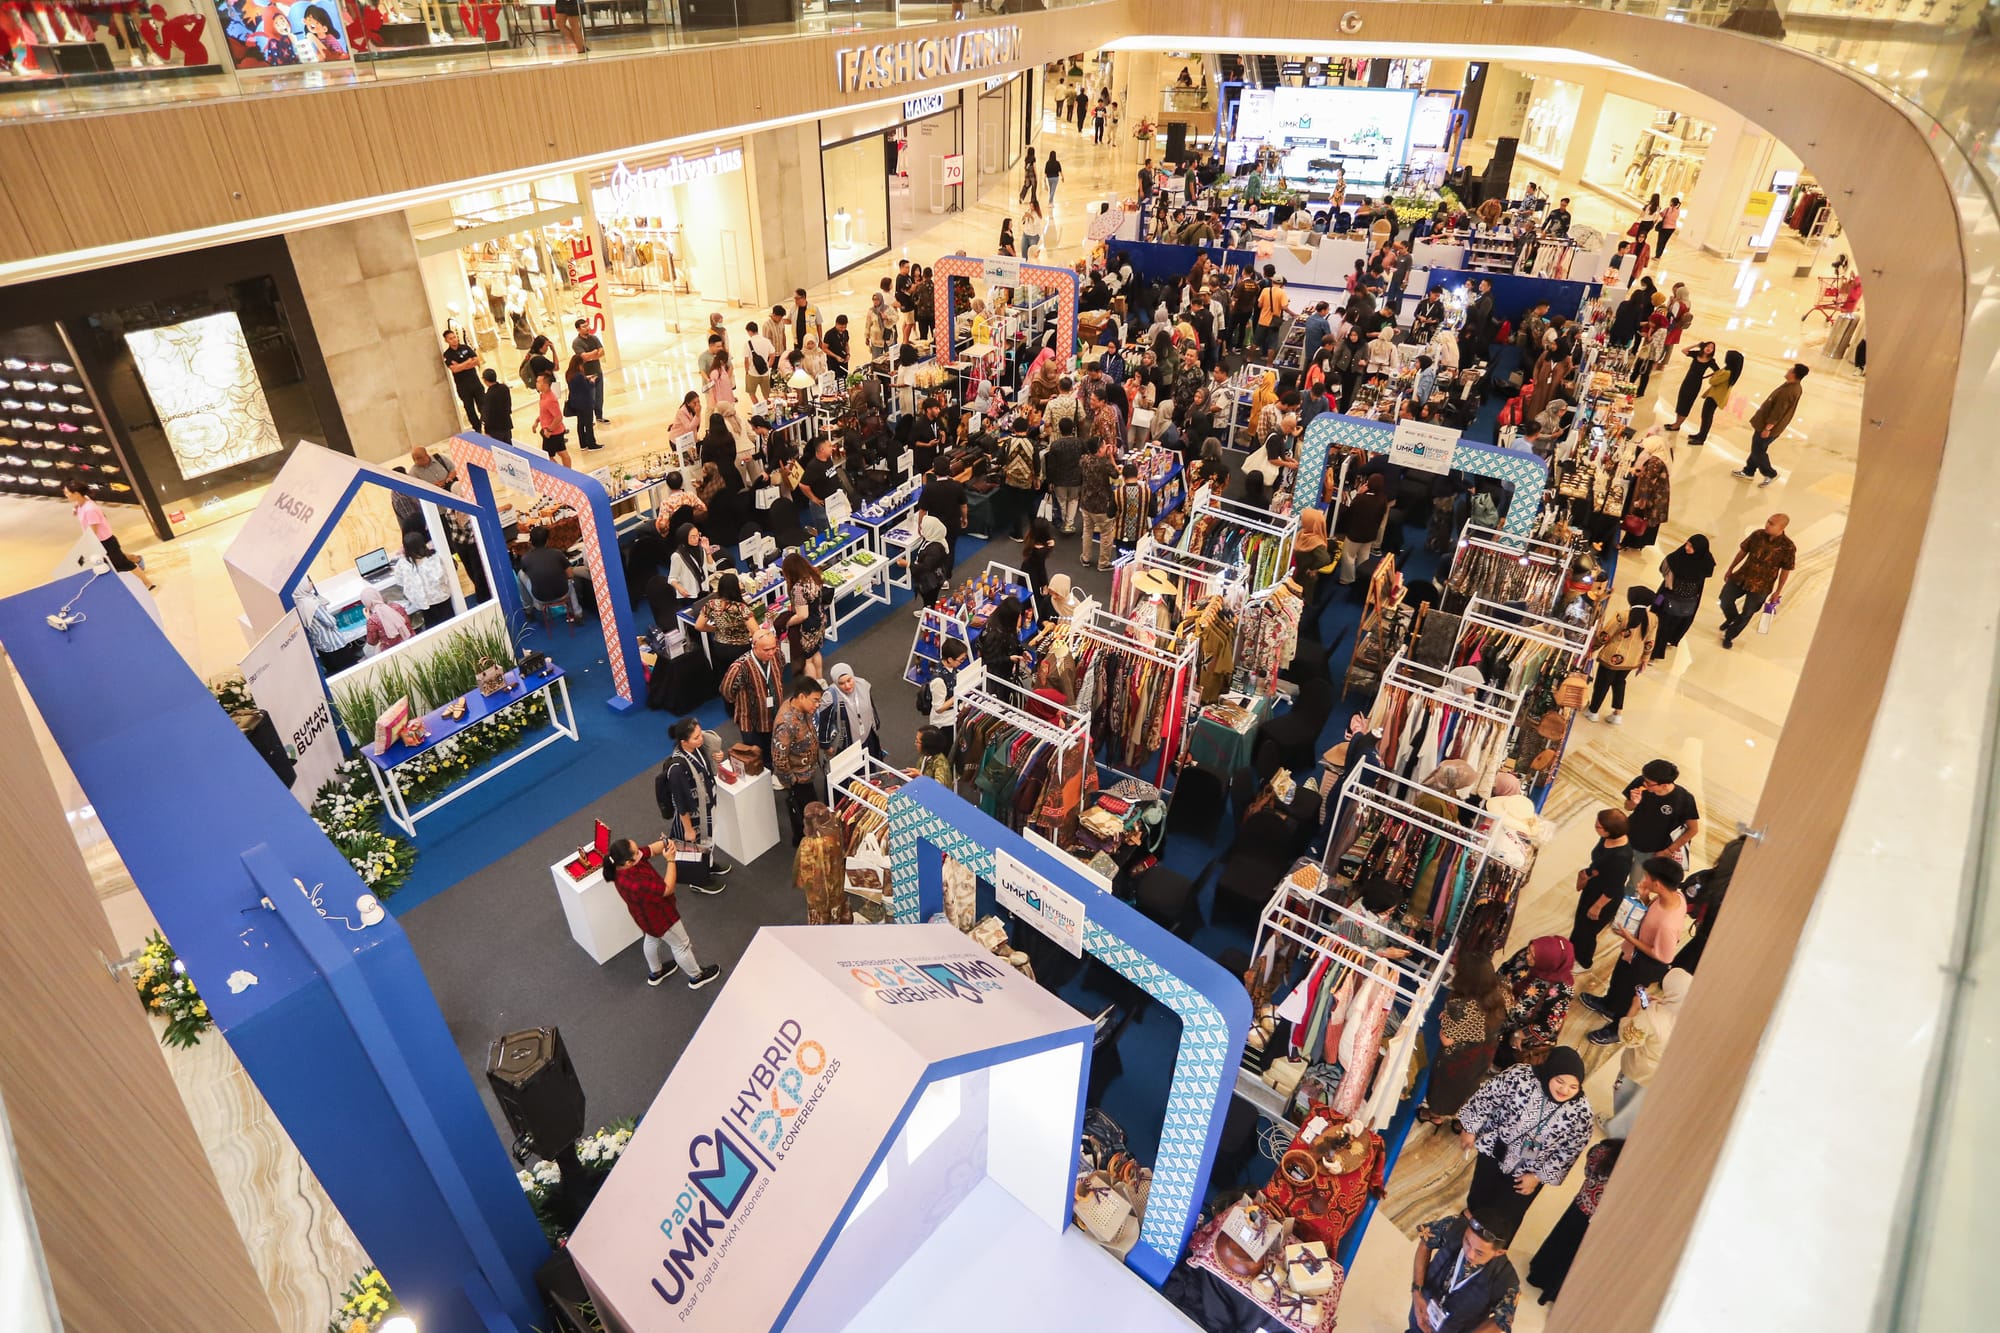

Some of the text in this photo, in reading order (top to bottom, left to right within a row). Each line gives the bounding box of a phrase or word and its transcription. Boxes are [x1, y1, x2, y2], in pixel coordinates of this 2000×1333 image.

[1340, 10, 1363, 34] G
[838, 26, 1023, 94] FASHION ATRIUM
[903, 93, 944, 120] MANGO
[946, 166, 961, 178] 70
[568, 257, 578, 286] 70%
[571, 235, 606, 335] SALE
[274, 492, 315, 524] KASIR
[293, 702, 326, 744] RUMAH
[296, 712, 330, 756] BUMN
[1045, 902, 1075, 927] HYBRID
[875, 984, 944, 1004] HYBRID
[730, 1019, 802, 1125] HYBRID
[750, 1039, 827, 1152] EXPO
[776, 1058, 841, 1161] & CONFERENCE 2025
[659, 1182, 698, 1240] PaDi
[678, 1176, 770, 1323] Pasar Digital UMKM Indonesia
